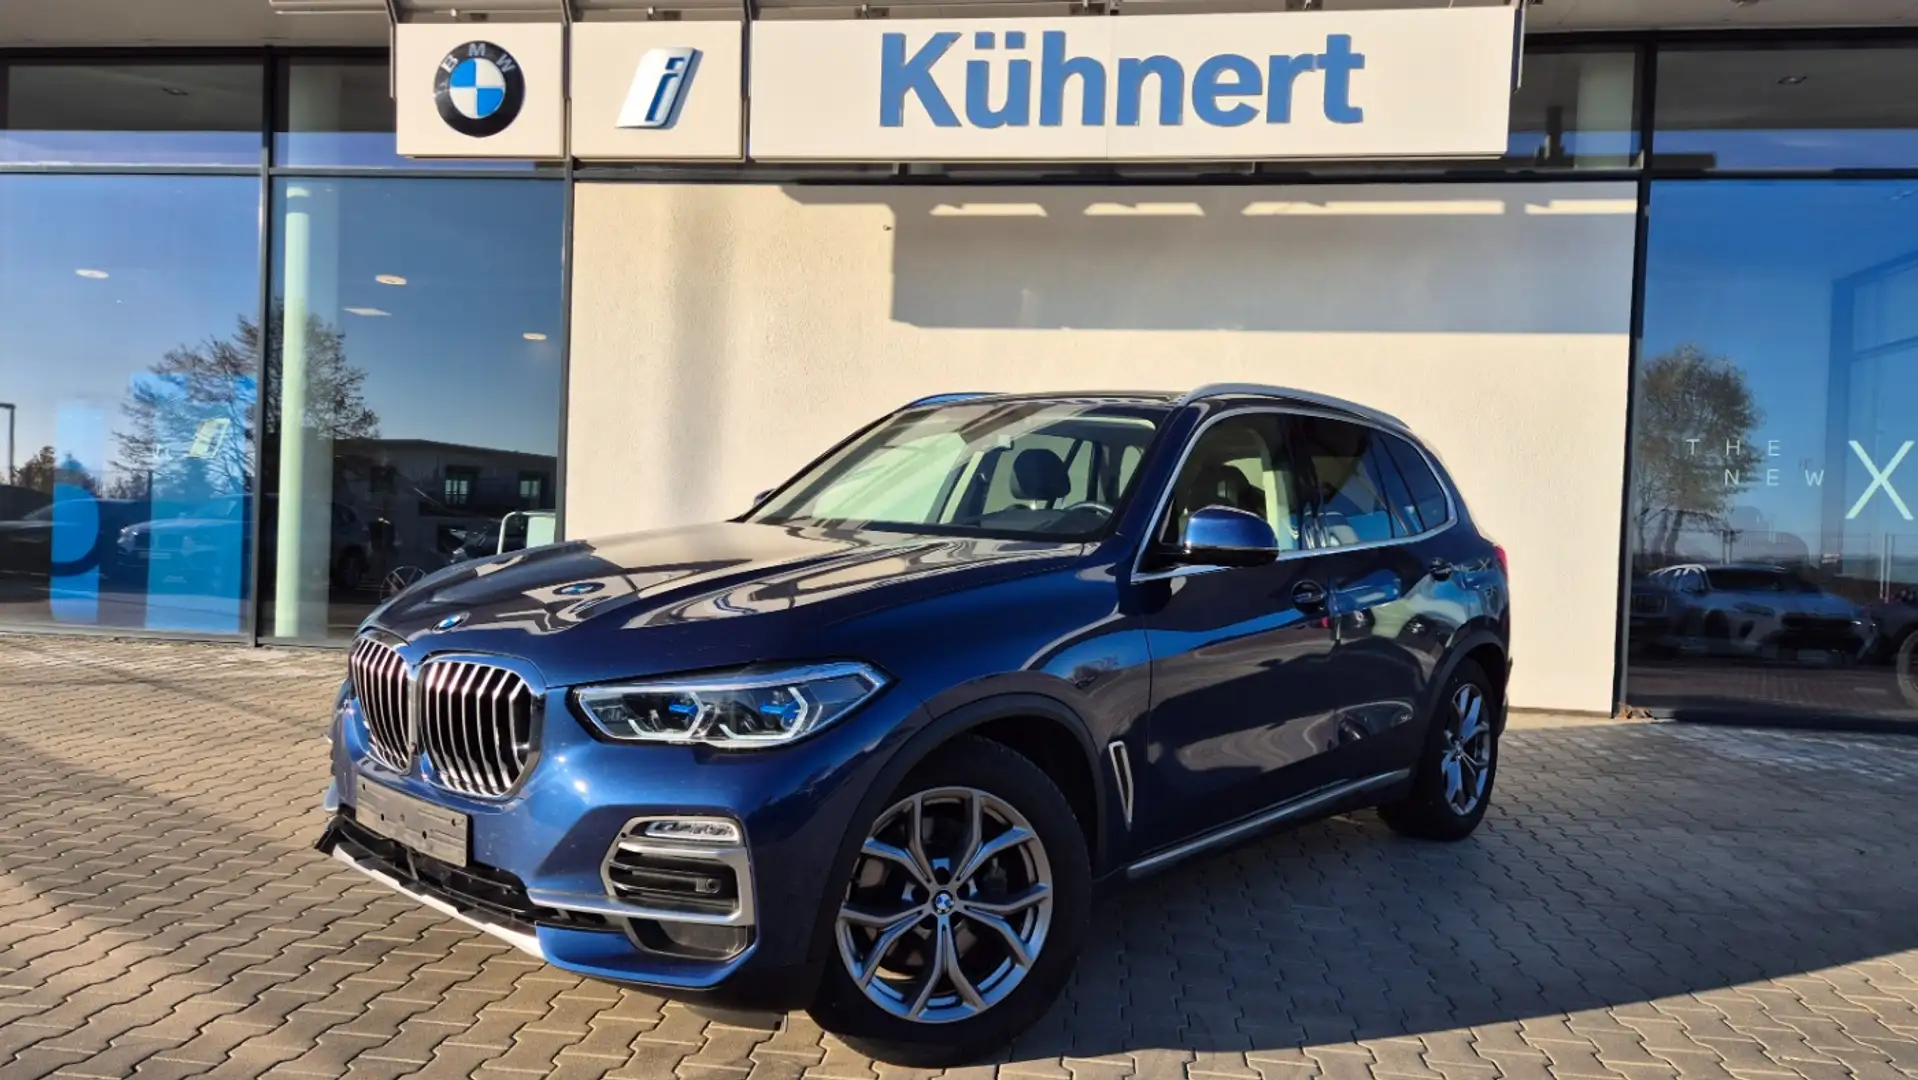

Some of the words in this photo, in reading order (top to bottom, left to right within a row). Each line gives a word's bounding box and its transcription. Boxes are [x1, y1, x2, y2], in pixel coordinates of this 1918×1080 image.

[440, 42, 517, 73] BMW
[879, 31, 1366, 129] Kühnert
[1686, 438, 1781, 457] THE
[1724, 468, 1825, 487] NEW
[1845, 440, 1916, 520] X
